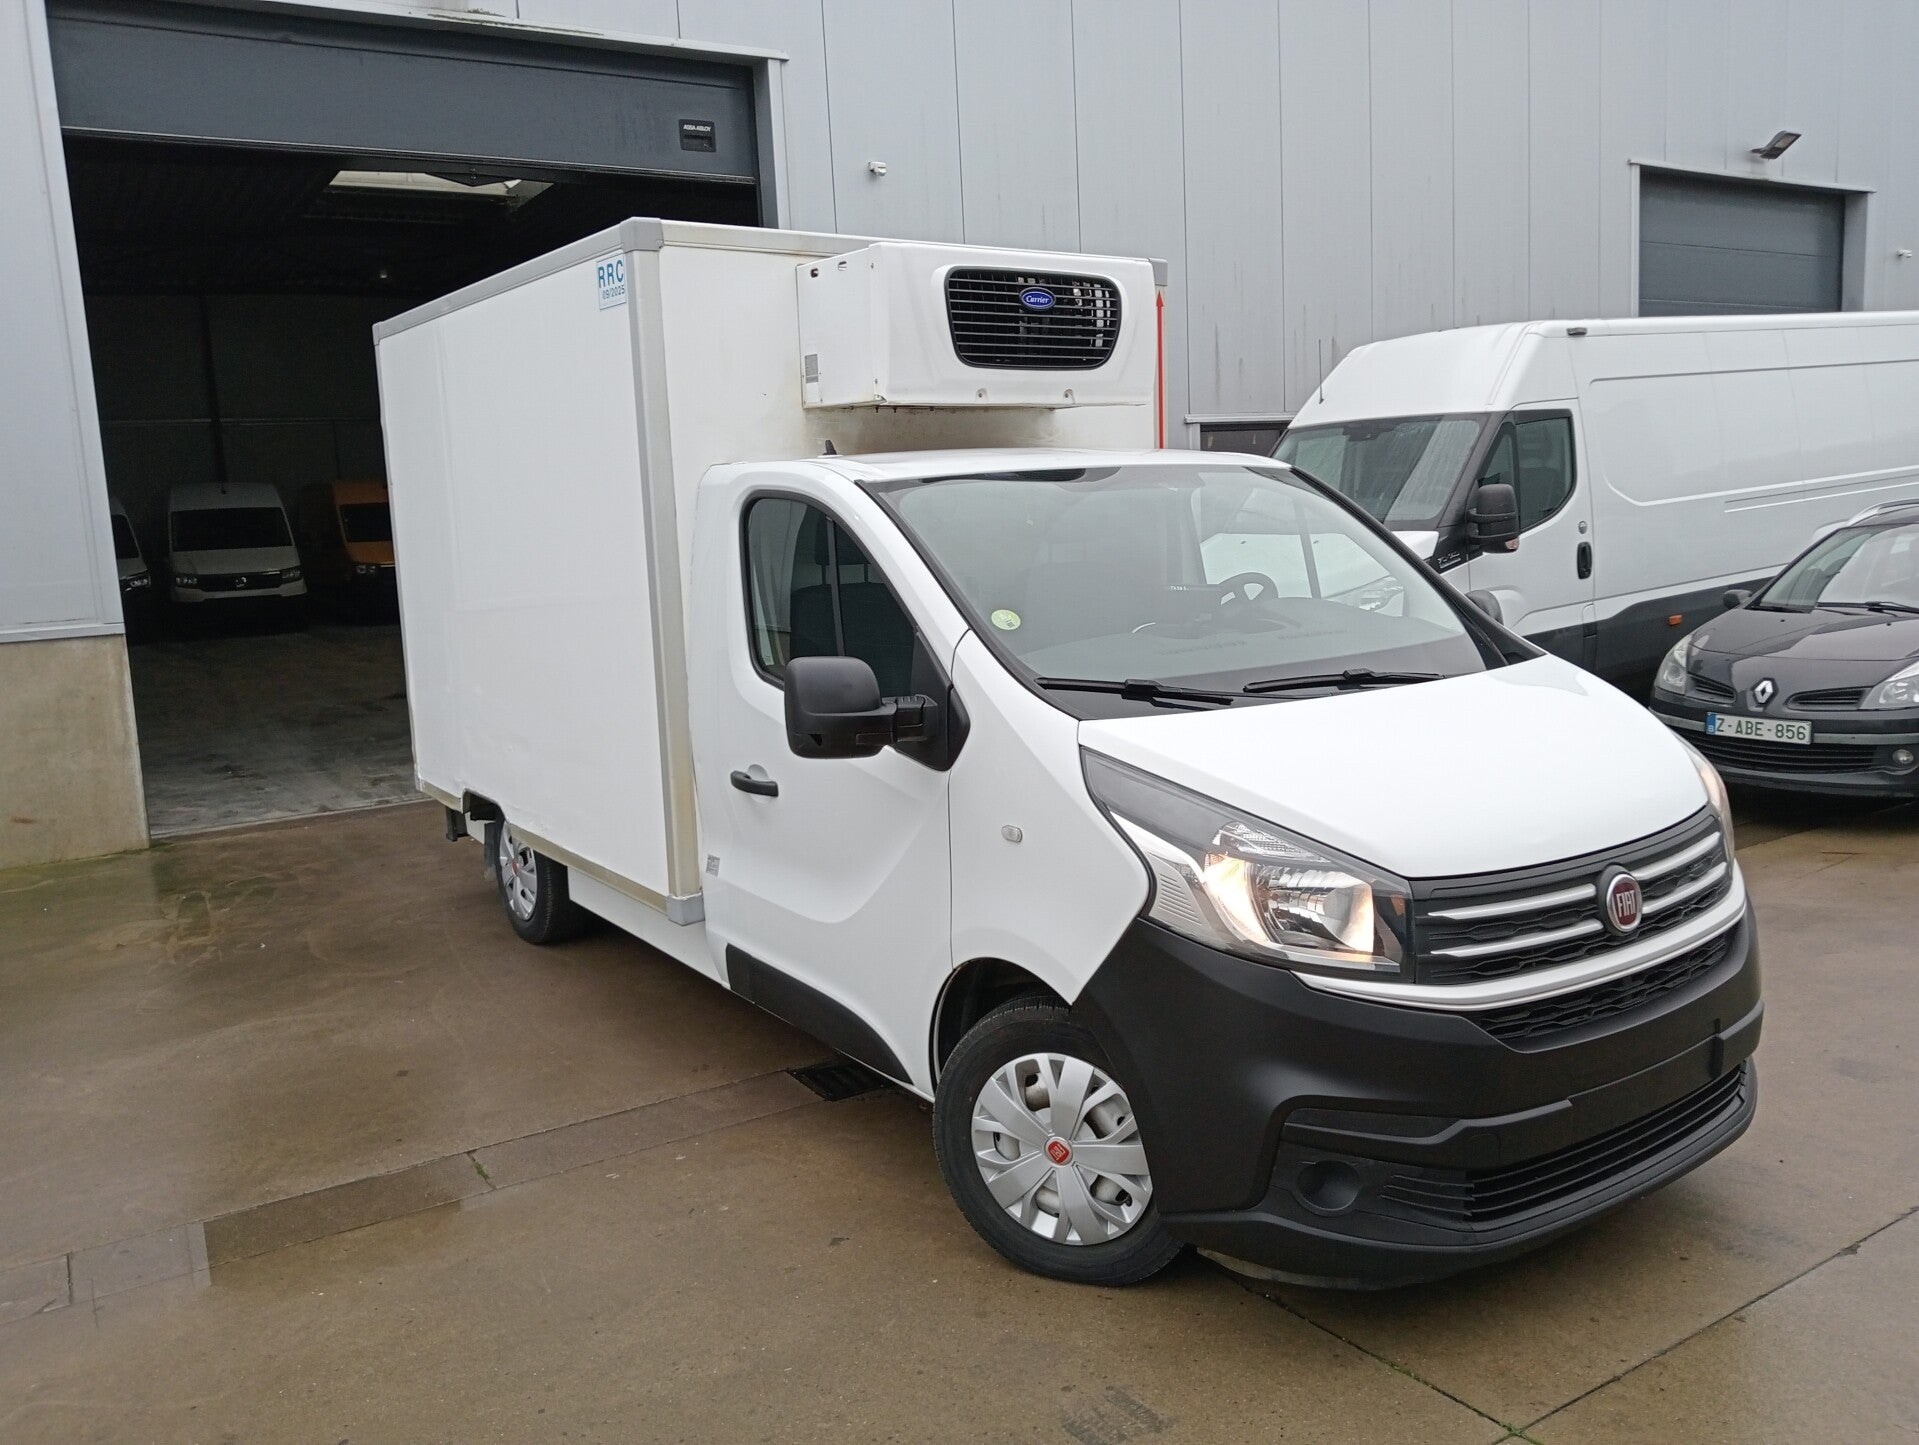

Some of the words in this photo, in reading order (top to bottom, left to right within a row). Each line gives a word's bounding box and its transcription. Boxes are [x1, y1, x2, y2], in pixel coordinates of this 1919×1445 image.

[598, 259, 624, 288] RRC
[602, 284, 625, 300] 09/2025
[1026, 295, 1050, 304] Carrier
[1615, 889, 1637, 918] FIAT
